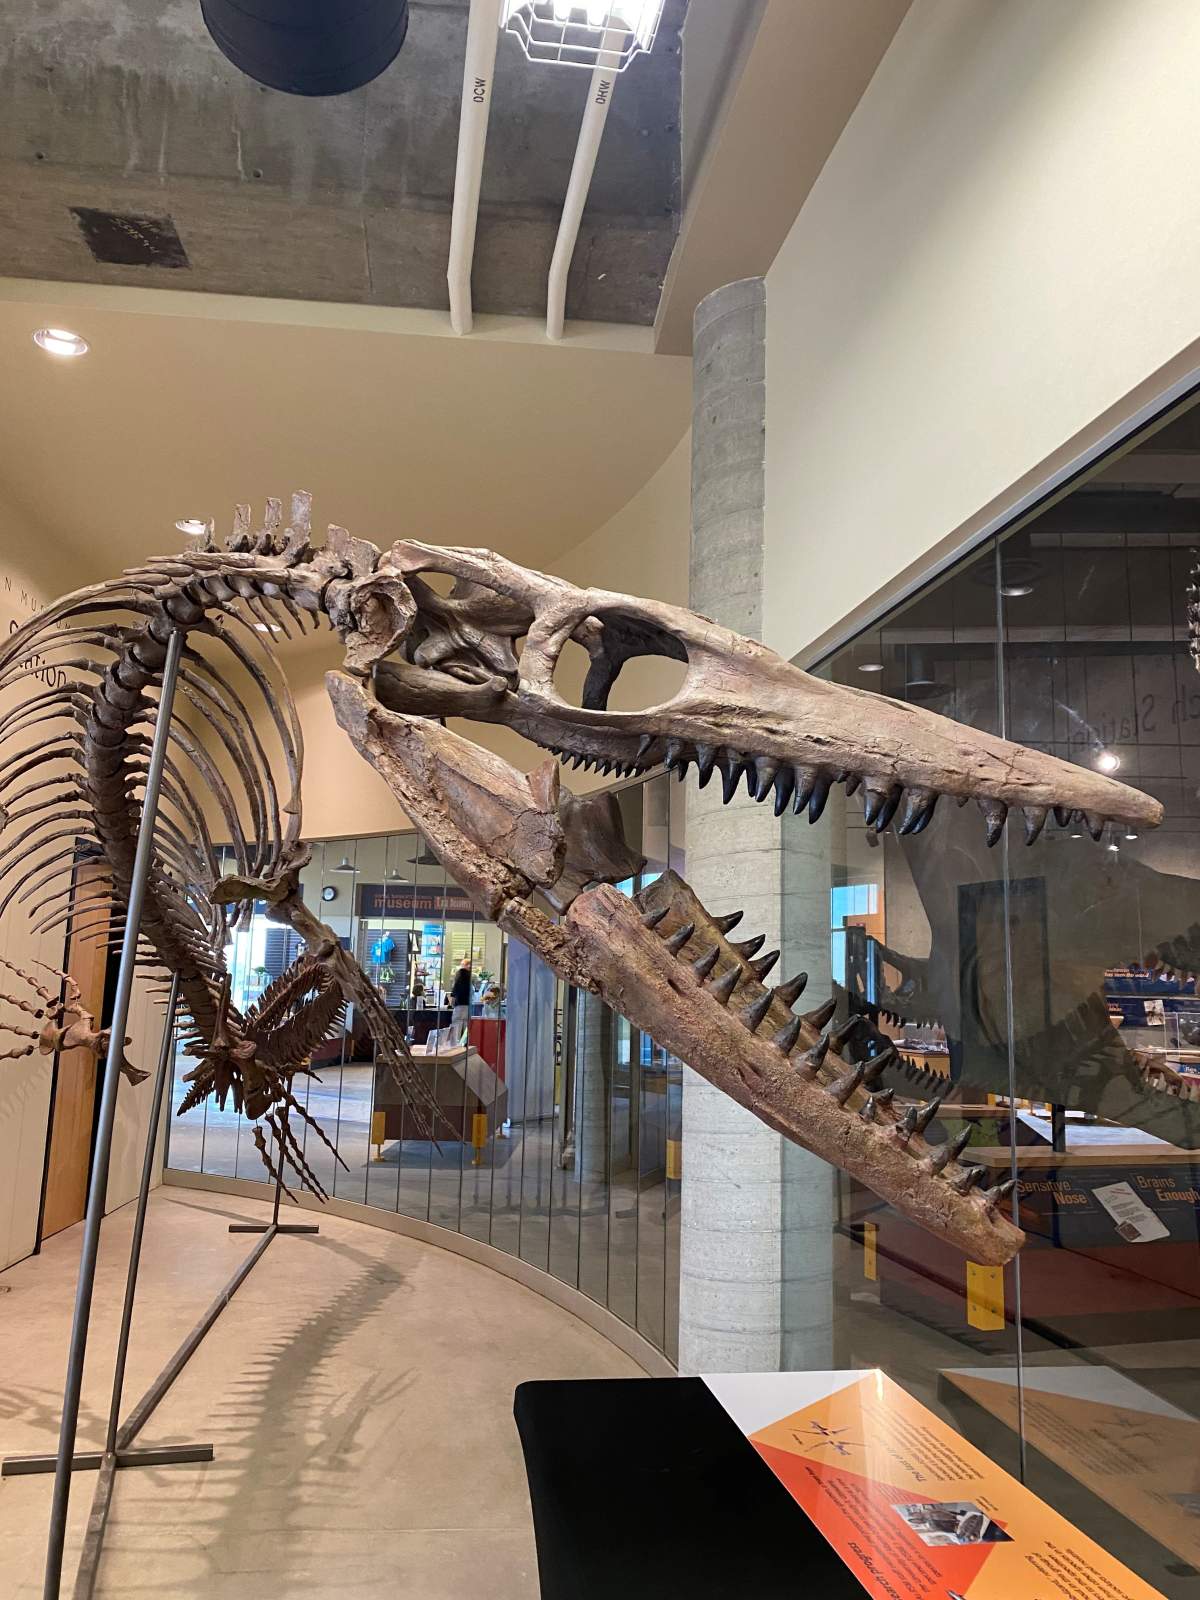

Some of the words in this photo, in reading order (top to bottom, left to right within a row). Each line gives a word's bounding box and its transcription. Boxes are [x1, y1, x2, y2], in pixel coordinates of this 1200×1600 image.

[473, 77, 487, 103] DCW
[595, 79, 611, 105] DHW
[374, 897, 432, 909] museum
[1016, 1179, 1071, 1193] Sensitive
[1136, 1175, 1176, 1189] Brains
[1053, 1191, 1088, 1205] Nose
[1155, 1187, 1200, 1203] Enough
[848, 1542, 884, 1576] progress
